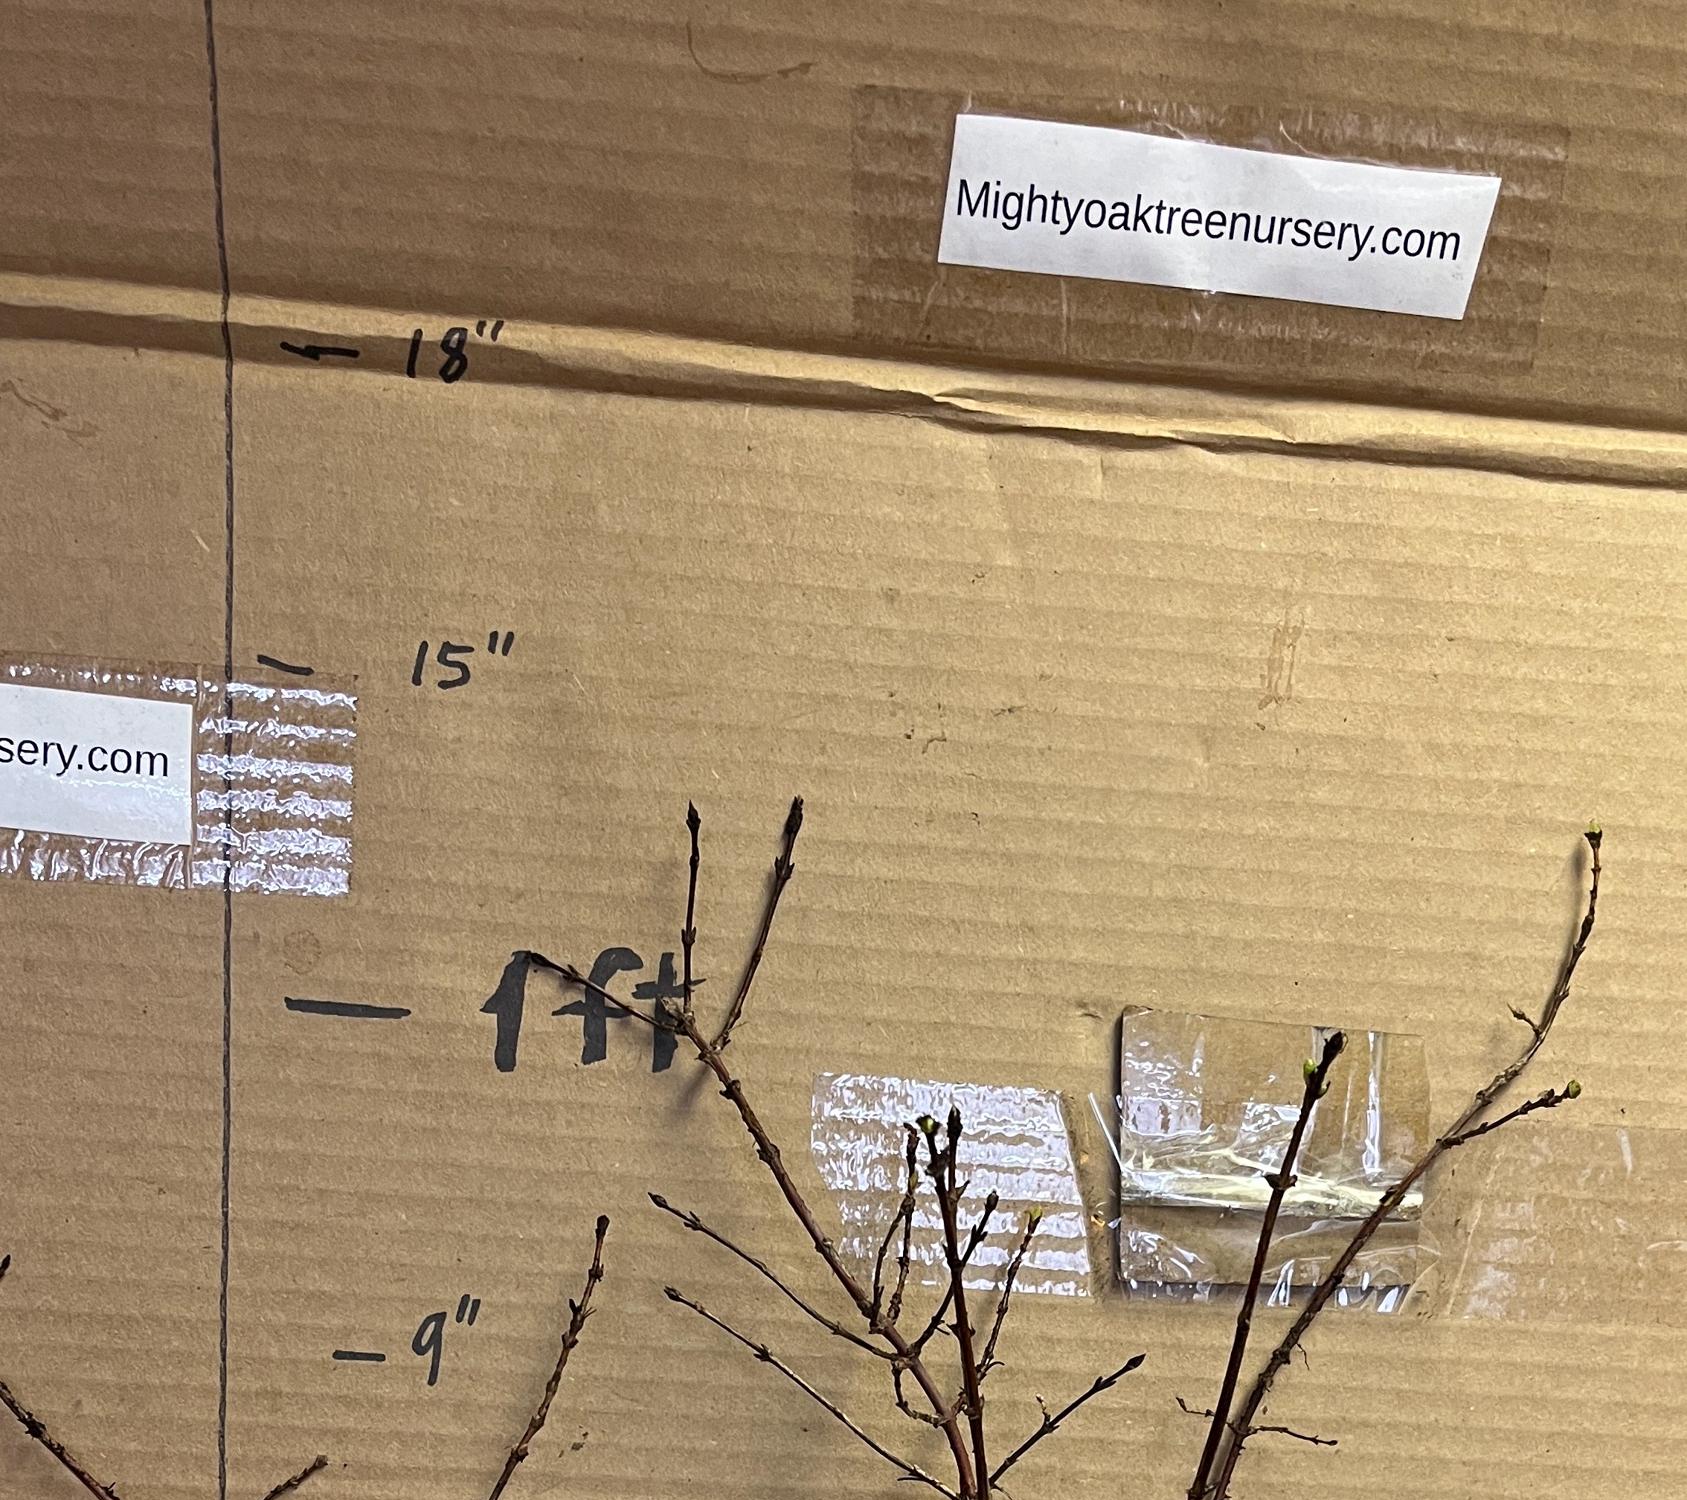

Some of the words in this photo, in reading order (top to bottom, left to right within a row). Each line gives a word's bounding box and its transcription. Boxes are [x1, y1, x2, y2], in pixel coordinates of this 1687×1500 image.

[956, 178, 1462, 261] Mightyoaktreenursery.com
[406, 320, 504, 384] 18"
[411, 631, 514, 690] 15"
[411, 1294, 481, 1386] 9"
